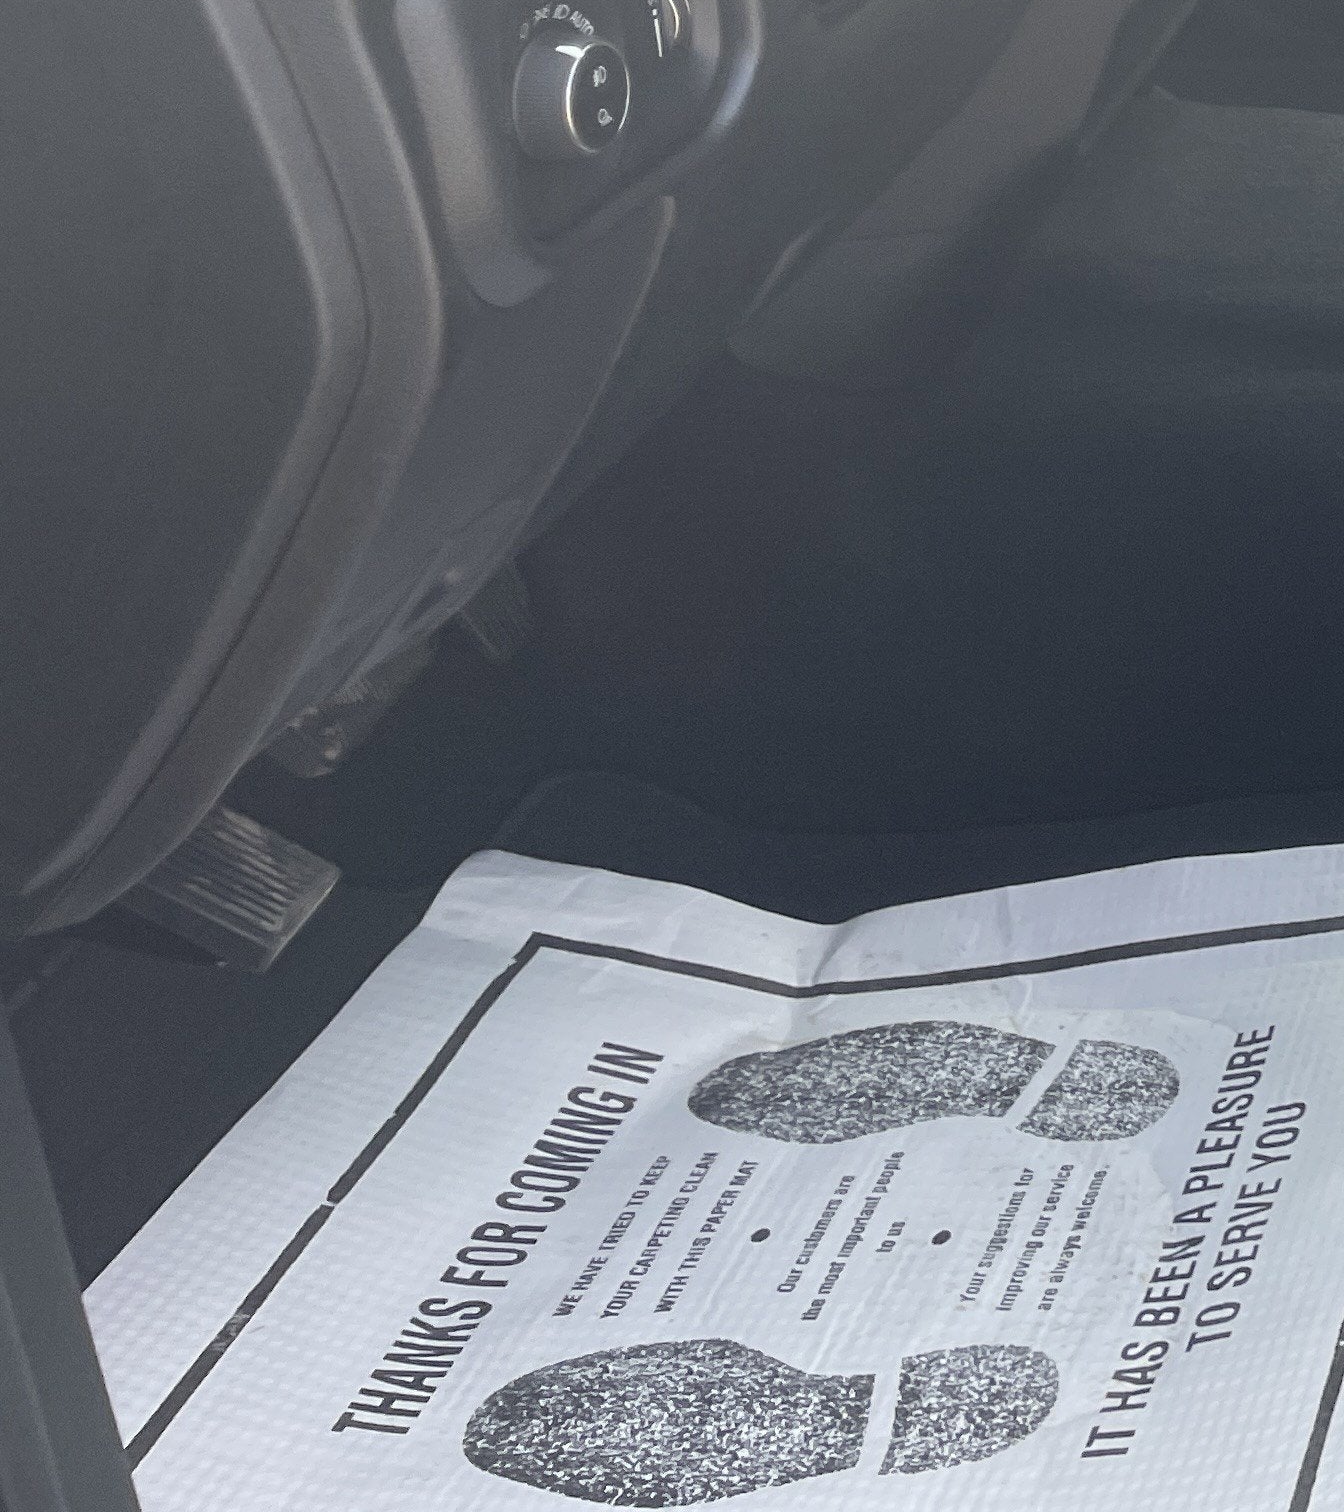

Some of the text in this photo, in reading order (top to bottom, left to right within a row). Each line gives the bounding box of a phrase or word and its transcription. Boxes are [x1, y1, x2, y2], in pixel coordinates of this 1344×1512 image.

[331, 1042, 664, 1435] THANKS FOR COMING IN
[552, 1155, 671, 1317] WE HAVE TRIED TO KEEP
[600, 1152, 719, 1319] YOUR CARPETING CLEAN
[653, 1160, 759, 1313] WITH THIS PAPER MAT
[776, 1175, 856, 1293] Our customers are
[800, 1151, 905, 1320] the most important people
[875, 1240, 896, 1253] to
[959, 1167, 1035, 1302] Your suggestions for
[1031, 1215, 1052, 1237] our
[1042, 1164, 1074, 1212] service
[1037, 1288, 1059, 1311] are
[1049, 1234, 1082, 1284] always
[1081, 1024, 1276, 1459] IT HAS BEEN A PLEASURE
[1186, 1101, 1307, 1353] TO SERVE YOU
